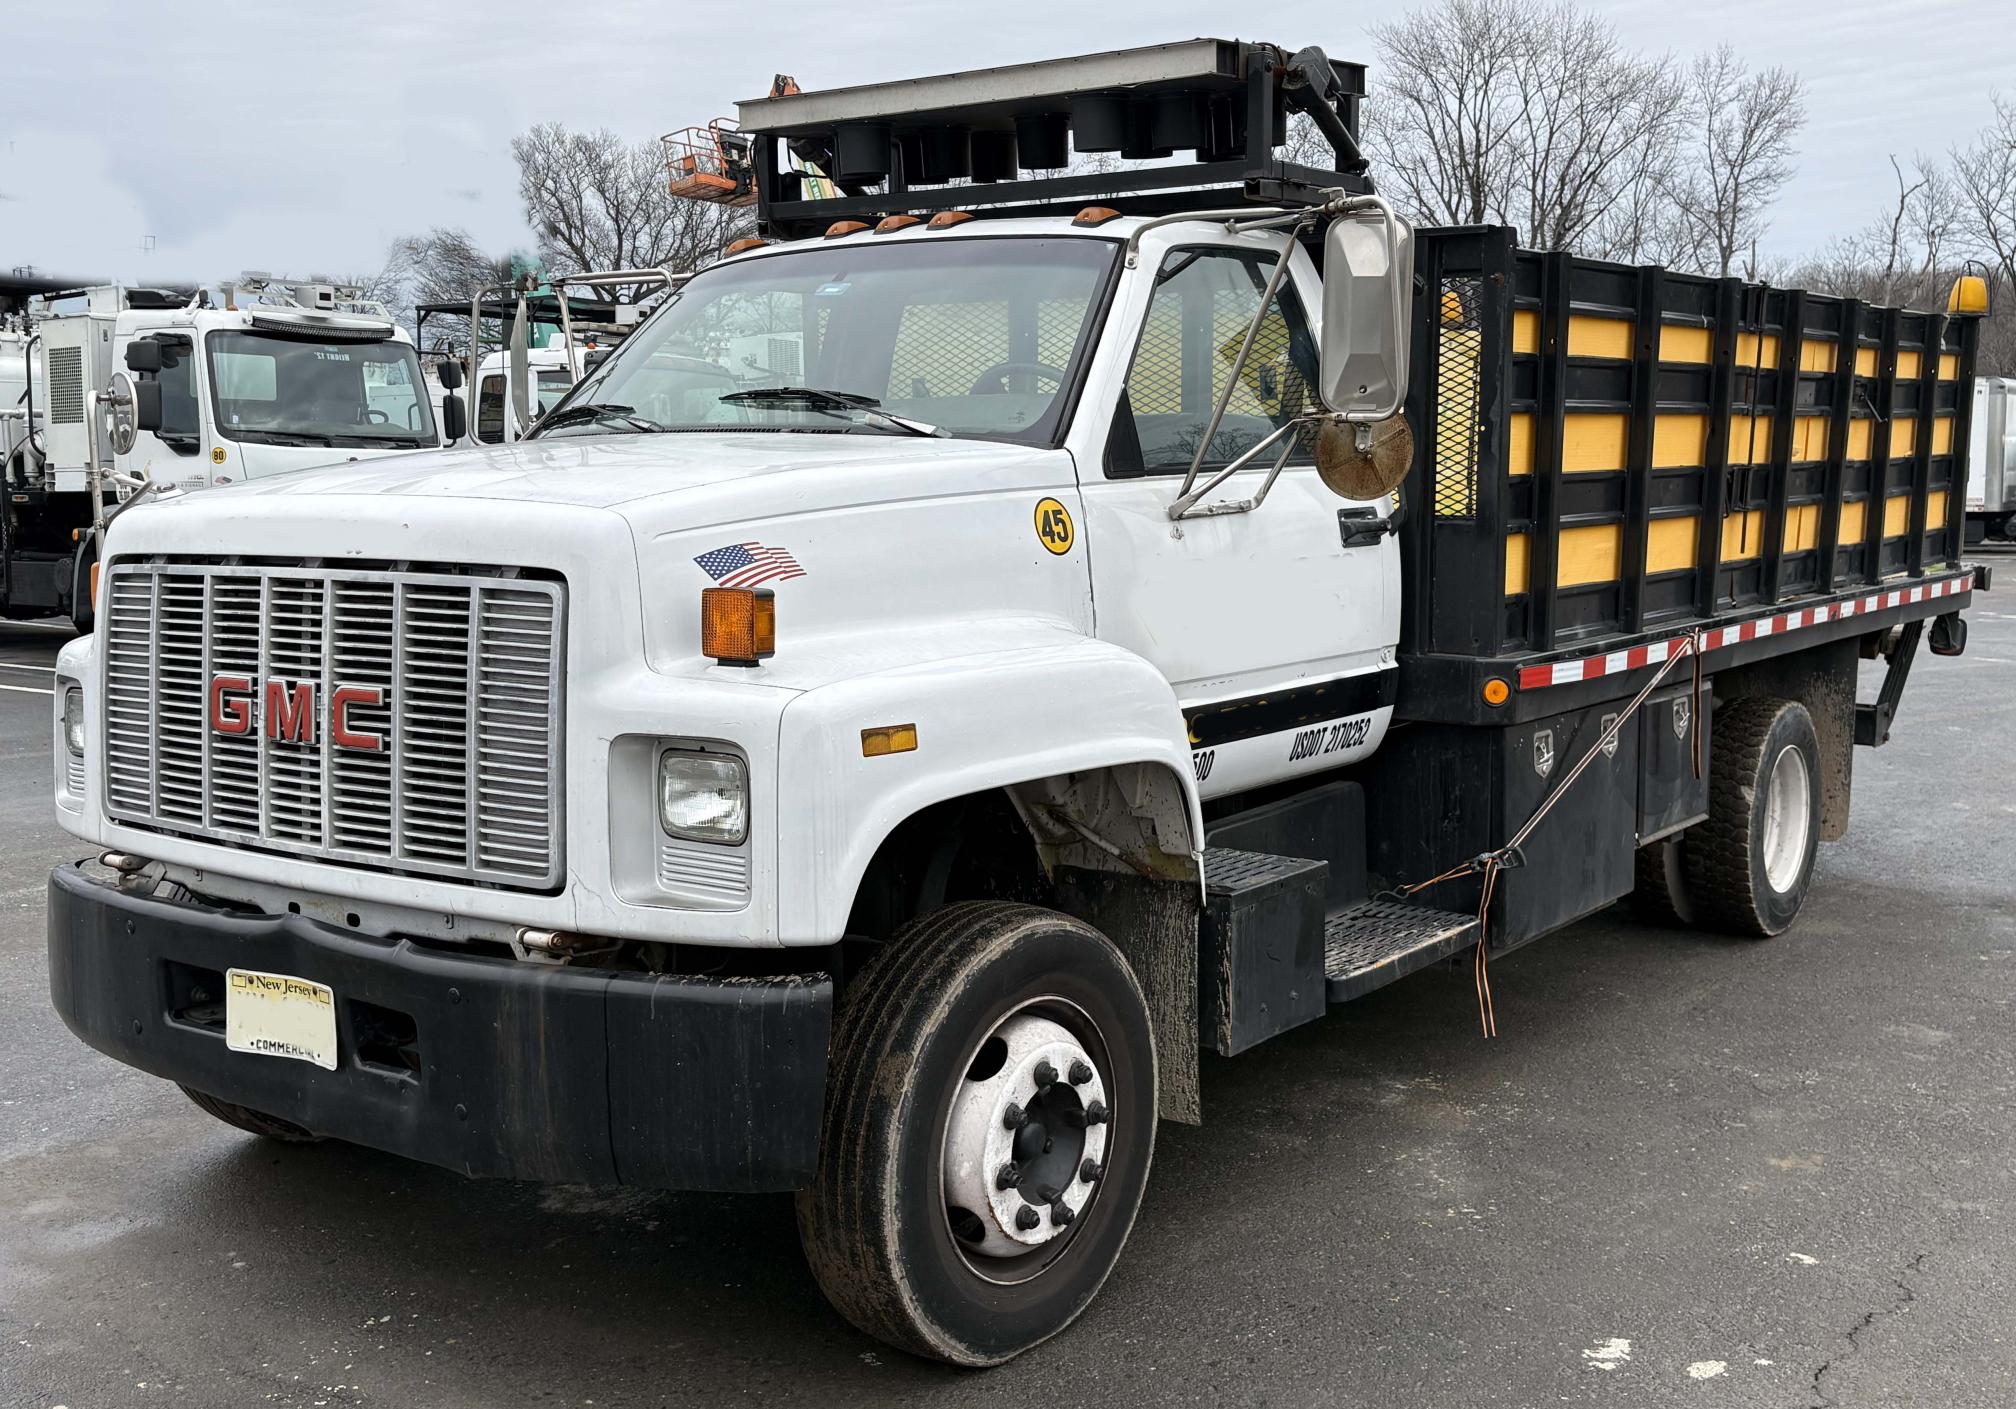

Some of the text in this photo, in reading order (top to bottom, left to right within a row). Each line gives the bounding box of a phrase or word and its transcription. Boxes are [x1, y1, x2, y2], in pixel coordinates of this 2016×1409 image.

[213, 450, 224, 461] 80
[1041, 509, 1069, 543] 45
[211, 674, 384, 752] GMC
[1289, 717, 1371, 762] USDOT 2170252
[256, 976, 313, 998] New Jersey
